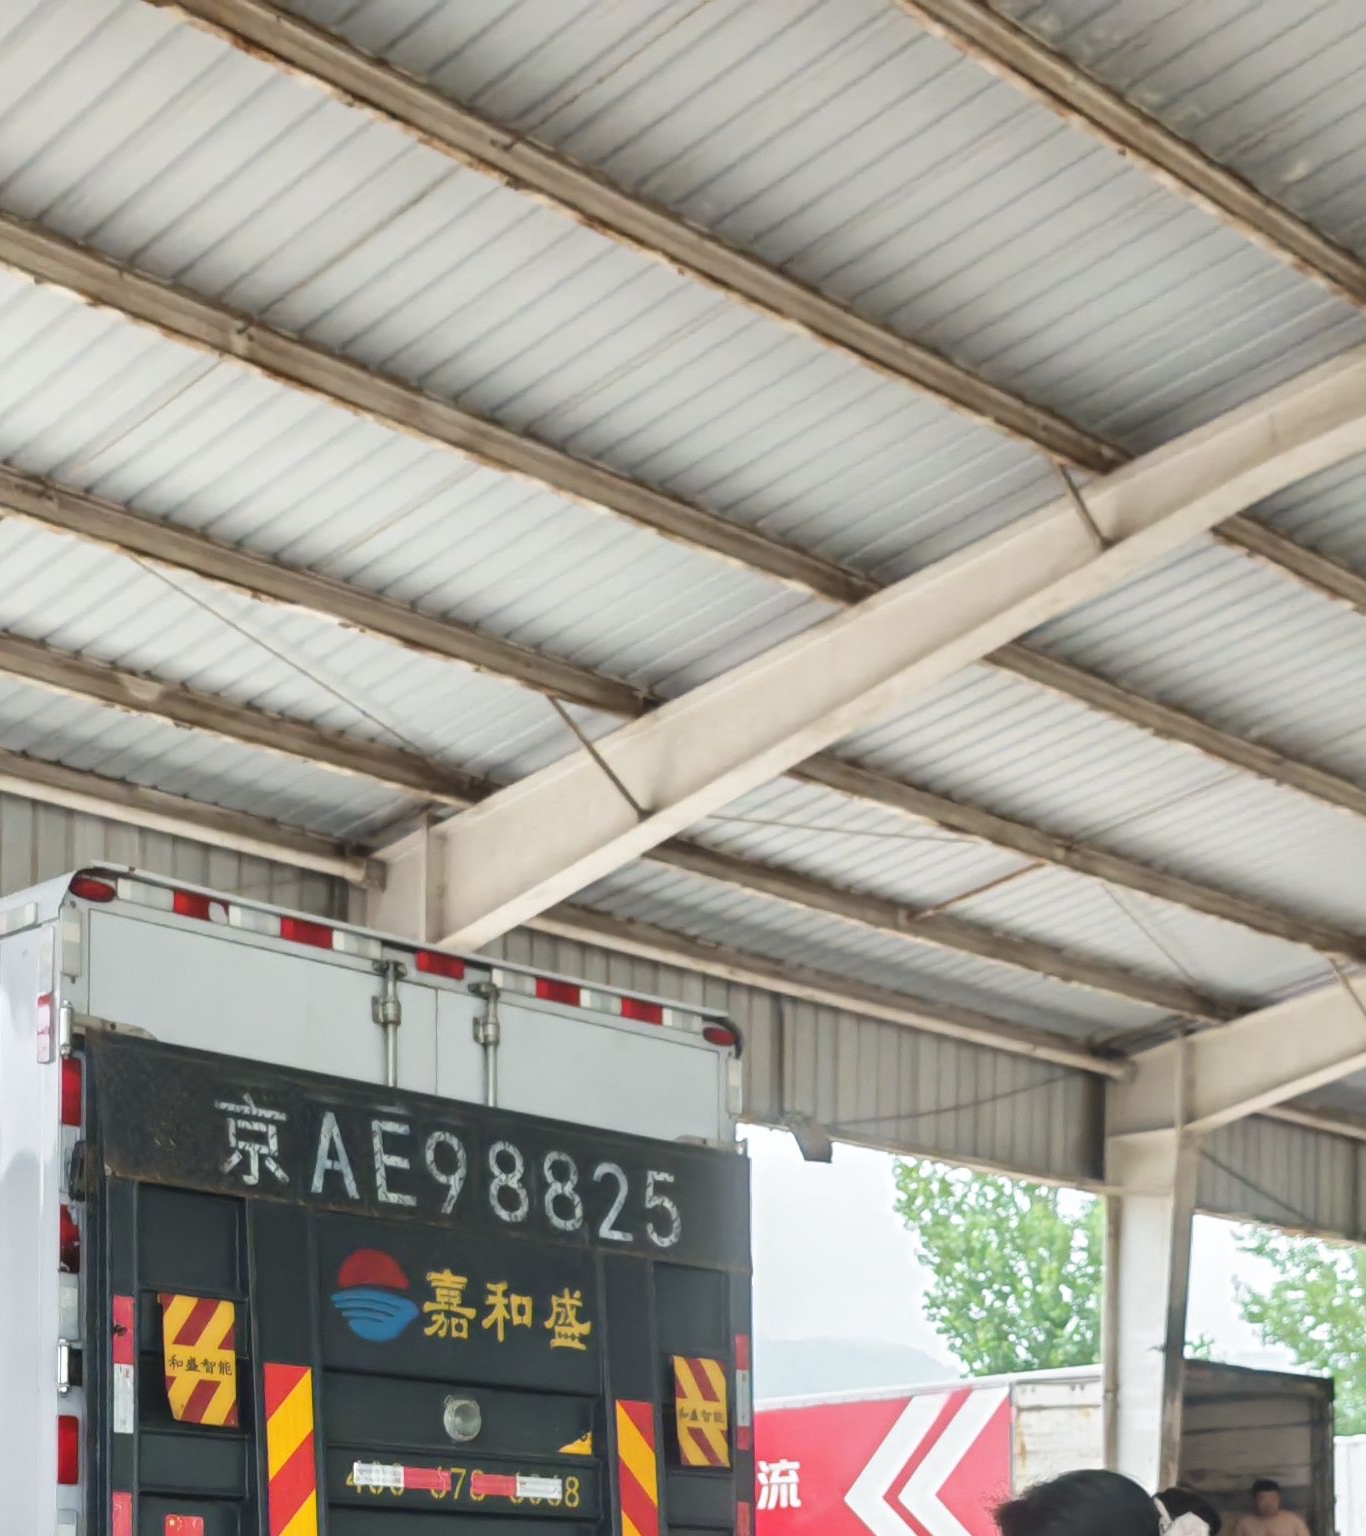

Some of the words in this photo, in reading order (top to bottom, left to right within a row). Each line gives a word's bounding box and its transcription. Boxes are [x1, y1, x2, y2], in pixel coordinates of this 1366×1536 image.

[215, 1092, 682, 1249] 京AE98825
[423, 1269, 592, 1350] 嘉和盛
[168, 1354, 233, 1376] 和盛智能
[757, 1459, 801, 1510] 流
